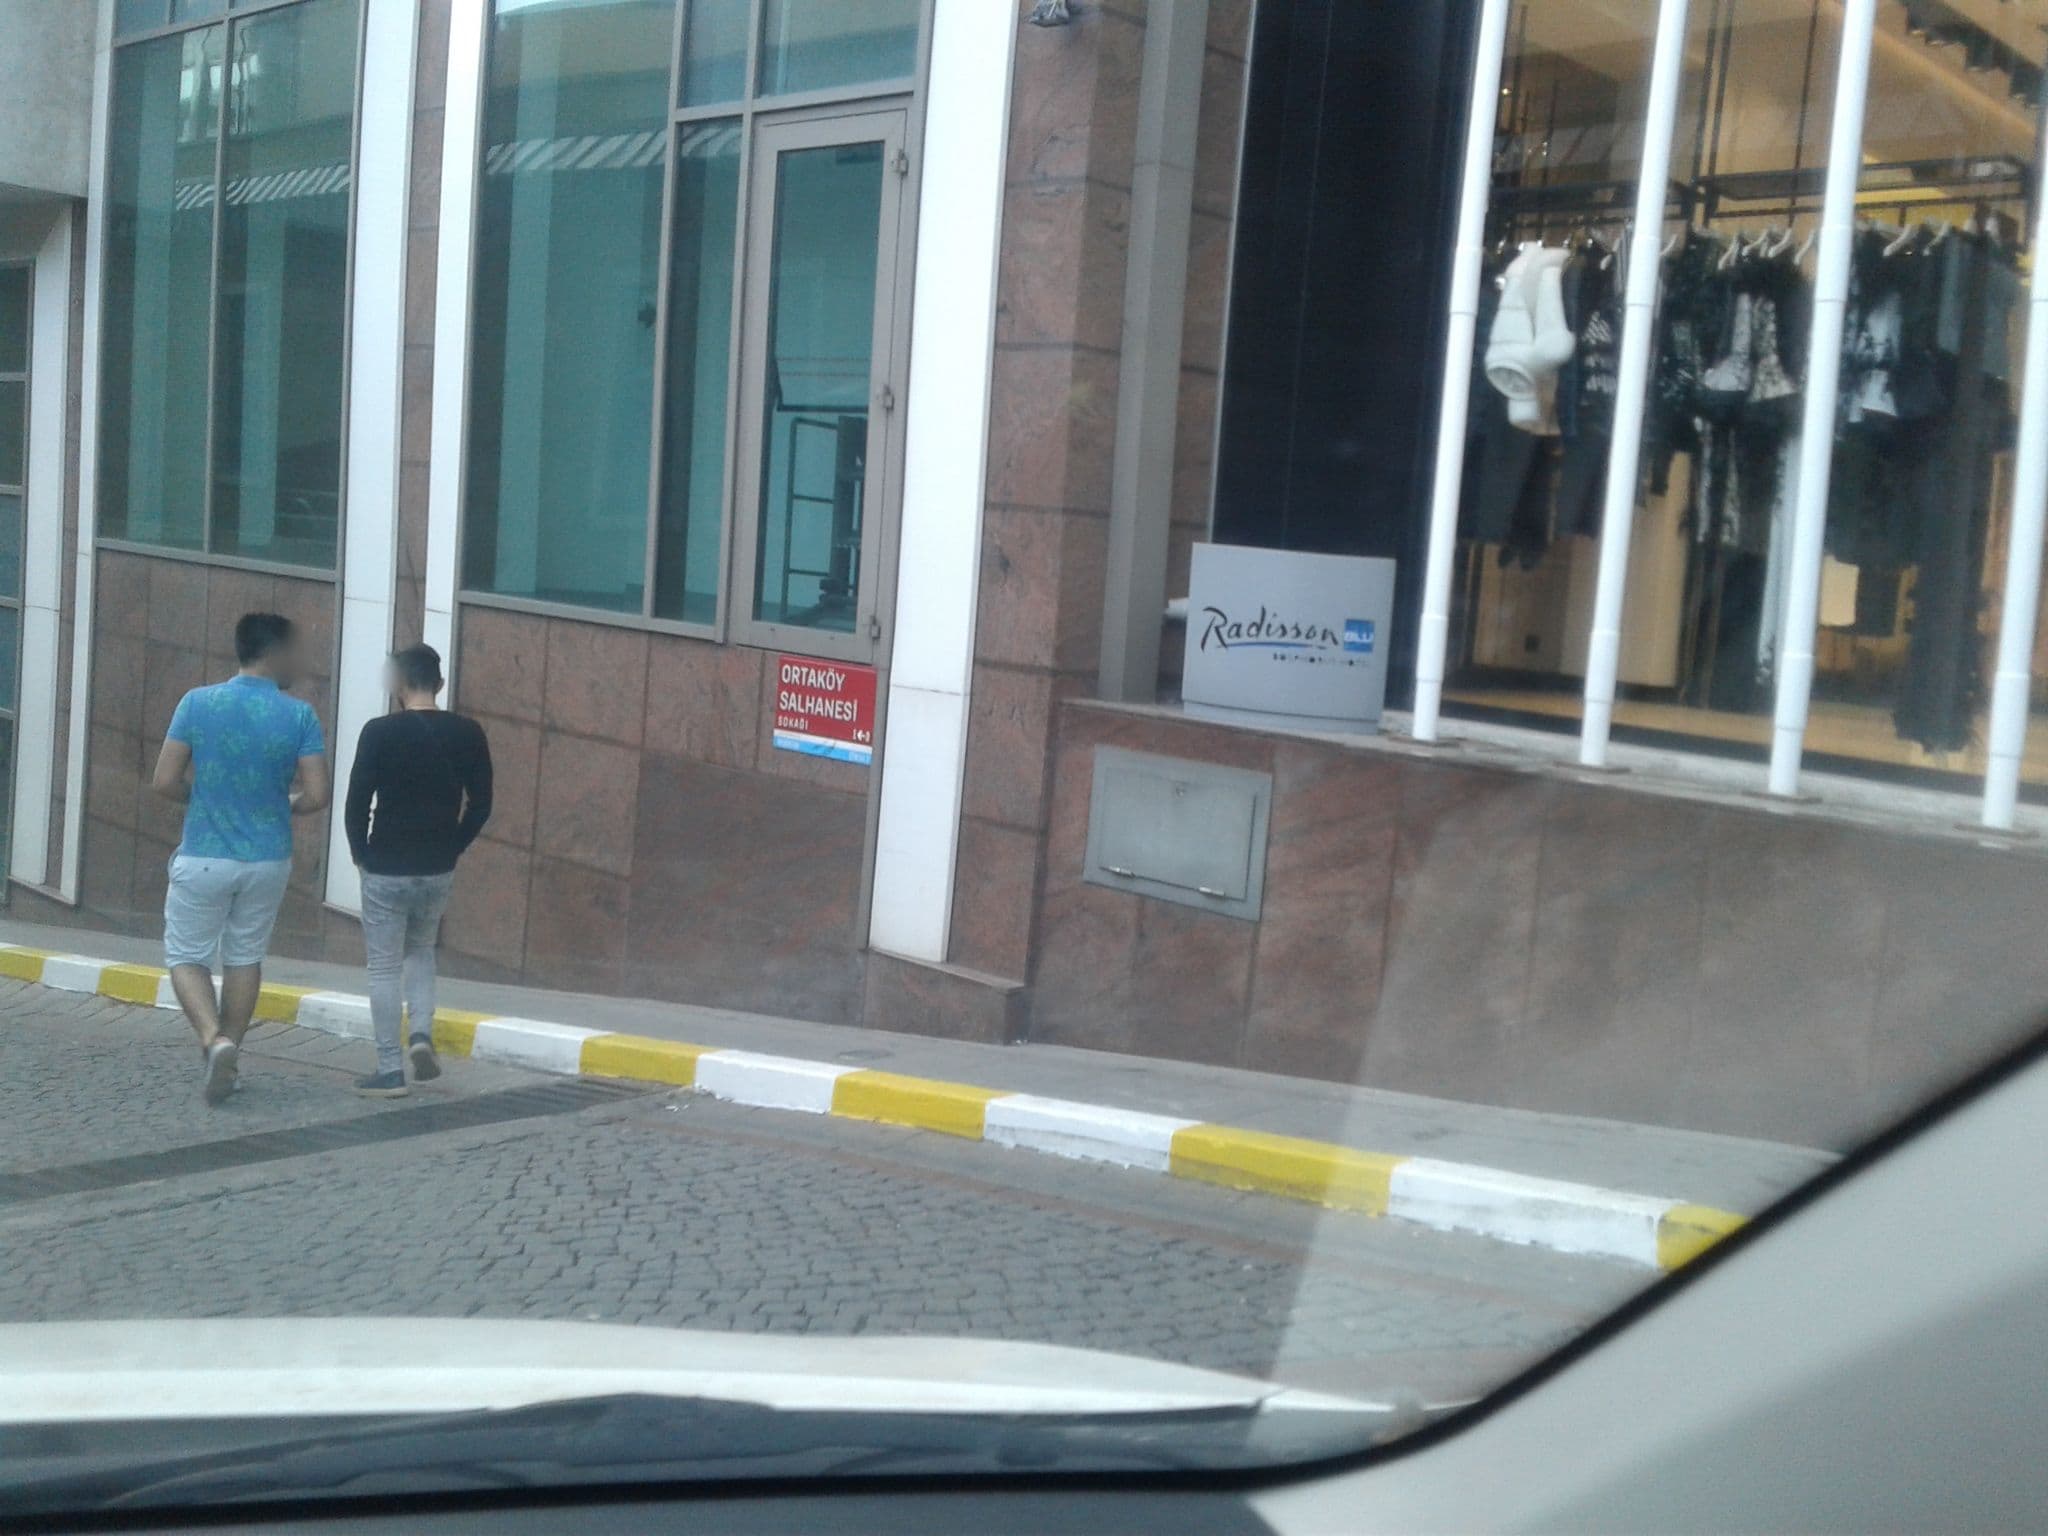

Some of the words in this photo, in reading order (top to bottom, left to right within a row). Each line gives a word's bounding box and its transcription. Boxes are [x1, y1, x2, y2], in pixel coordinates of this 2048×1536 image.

[1200, 605, 1339, 652] Radisson
[781, 664, 846, 692] ORTAKÖY
[779, 690, 858, 722] SALHANESİ
